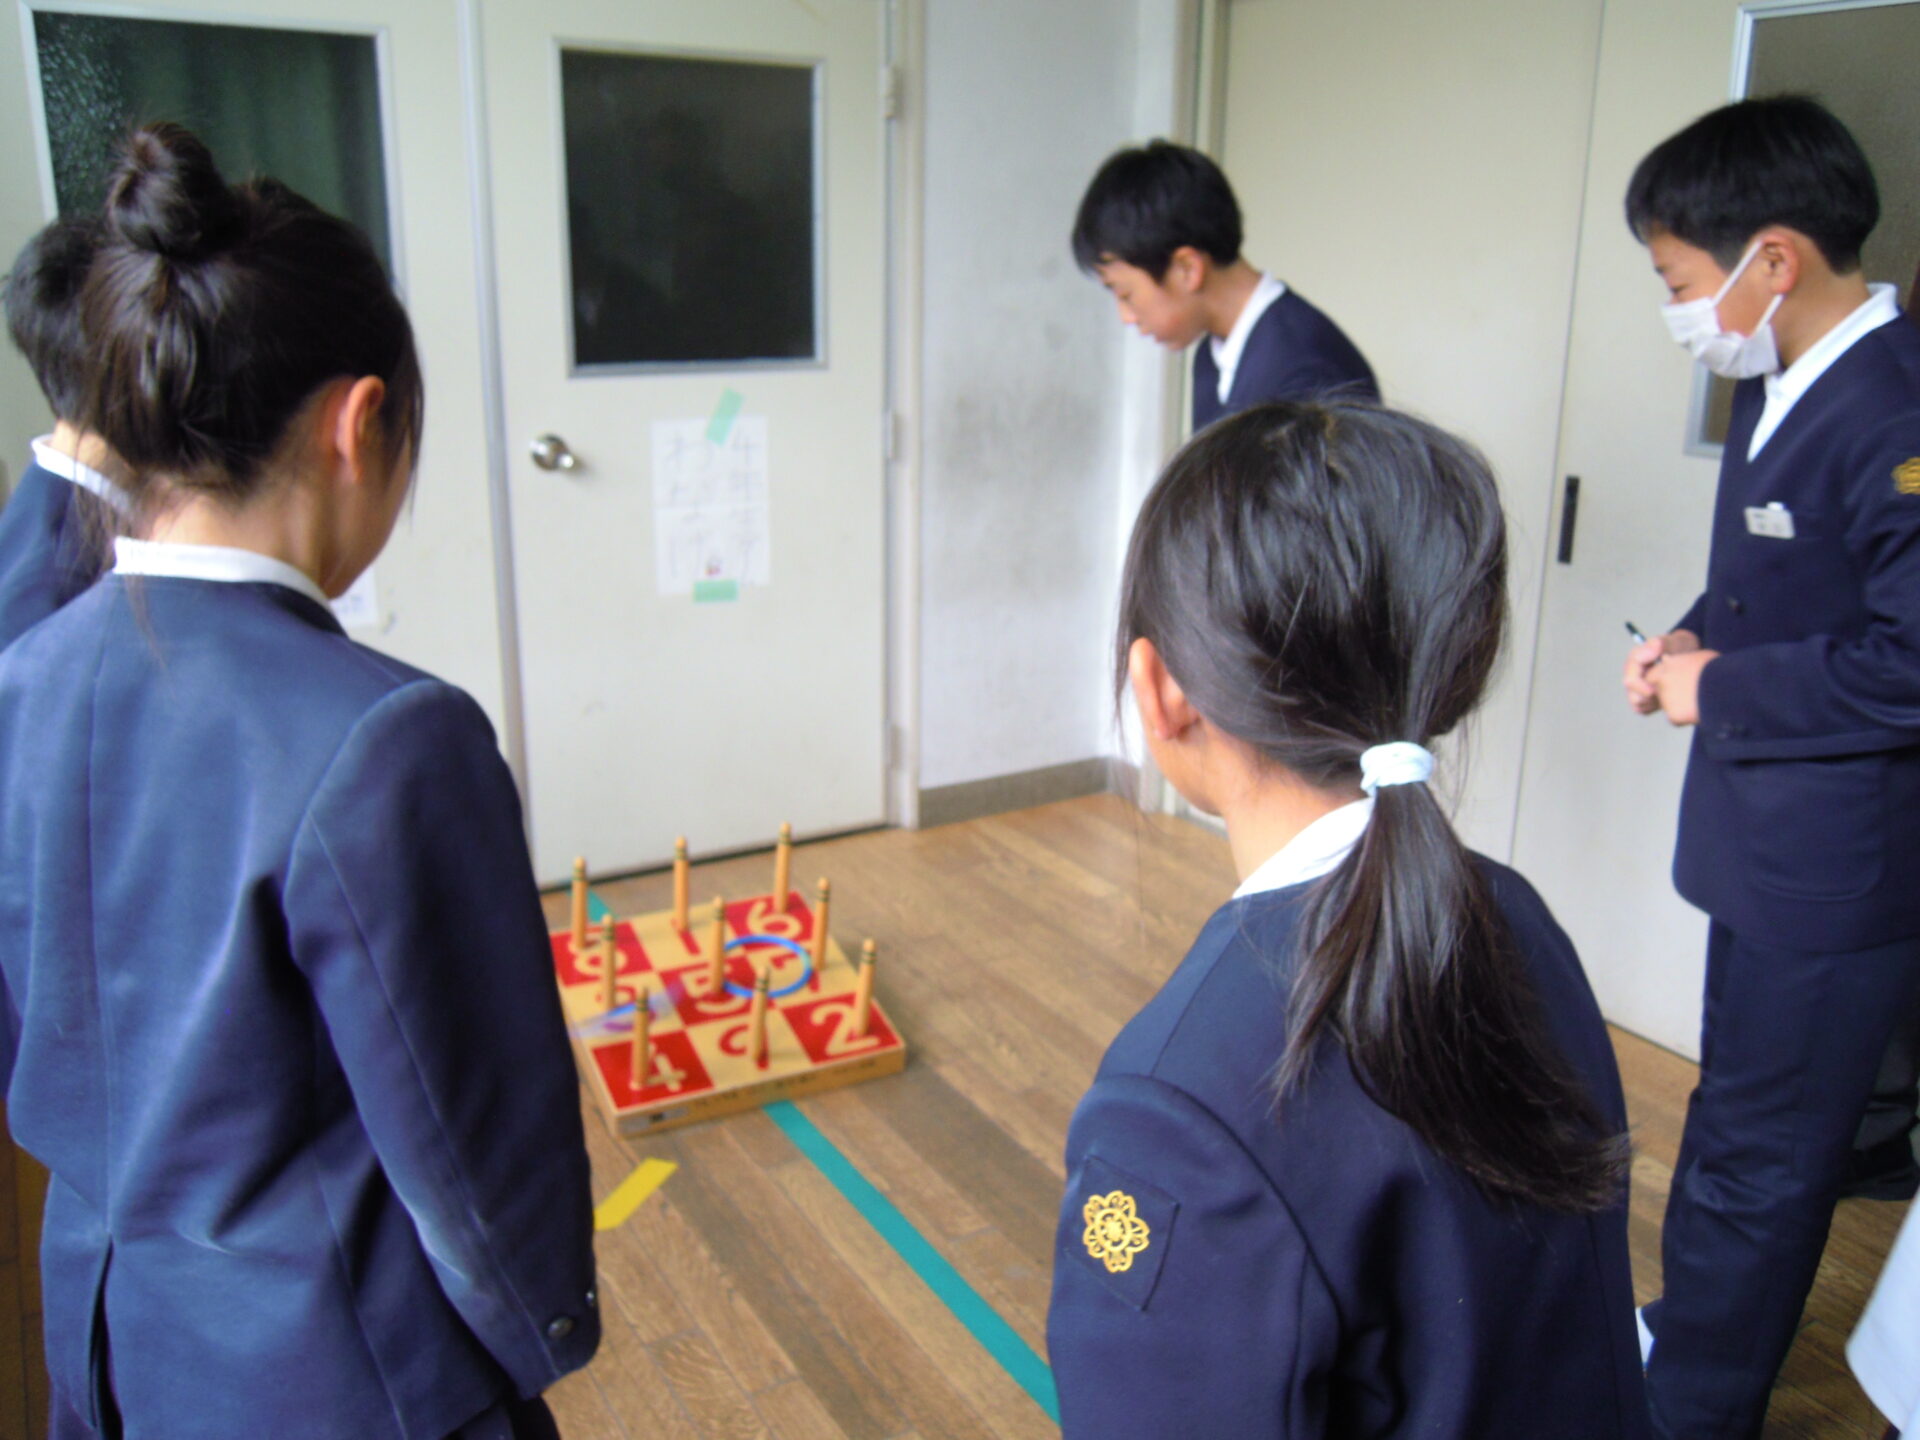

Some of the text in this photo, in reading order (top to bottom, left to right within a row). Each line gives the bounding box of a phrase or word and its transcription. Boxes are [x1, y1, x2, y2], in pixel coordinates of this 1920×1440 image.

[746, 900, 803, 941] 6
[680, 962, 750, 1013] 5
[629, 1003, 880, 1092] 4 9 2
